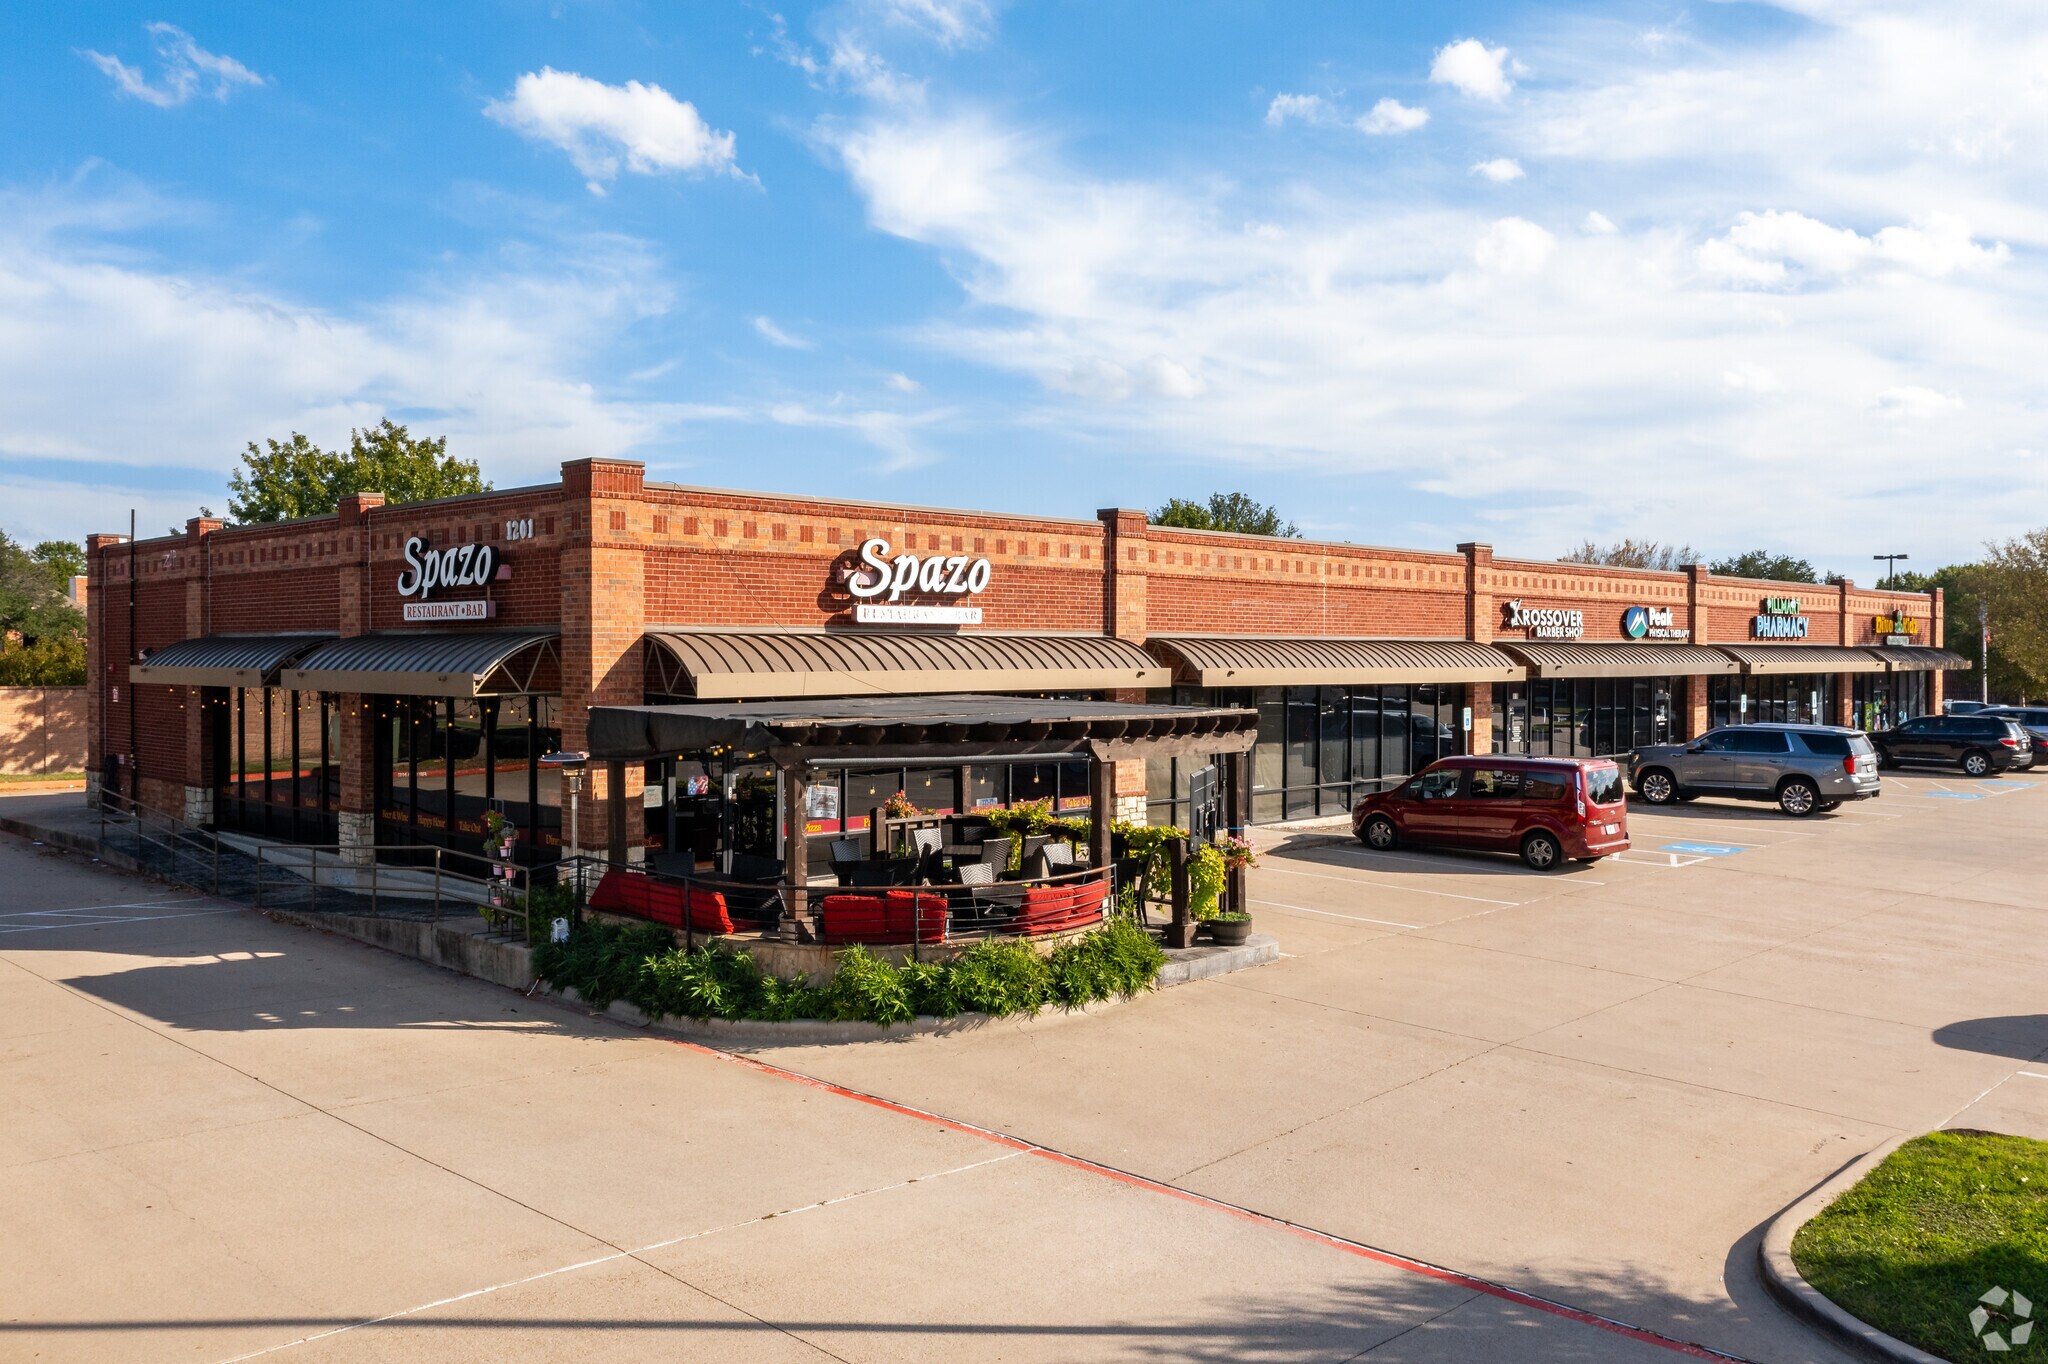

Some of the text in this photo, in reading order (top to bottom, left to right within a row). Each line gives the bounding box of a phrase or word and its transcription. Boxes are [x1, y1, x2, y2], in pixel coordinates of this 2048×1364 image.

[505, 518, 534, 541] 1201
[397, 536, 492, 599] Spazo
[848, 538, 991, 601] Spazo
[406, 603, 484, 618] RESTAURANT BAR
[1510, 599, 1584, 627] KROSSOVER
[1649, 607, 1673, 626] Peak
[1766, 598, 1801, 615] PILLMART
[1536, 626, 1584, 638] BARBER SHOP
[1649, 628, 1690, 638] PHYSICAL THERAPY
[1756, 615, 1809, 638] PHARMACY
